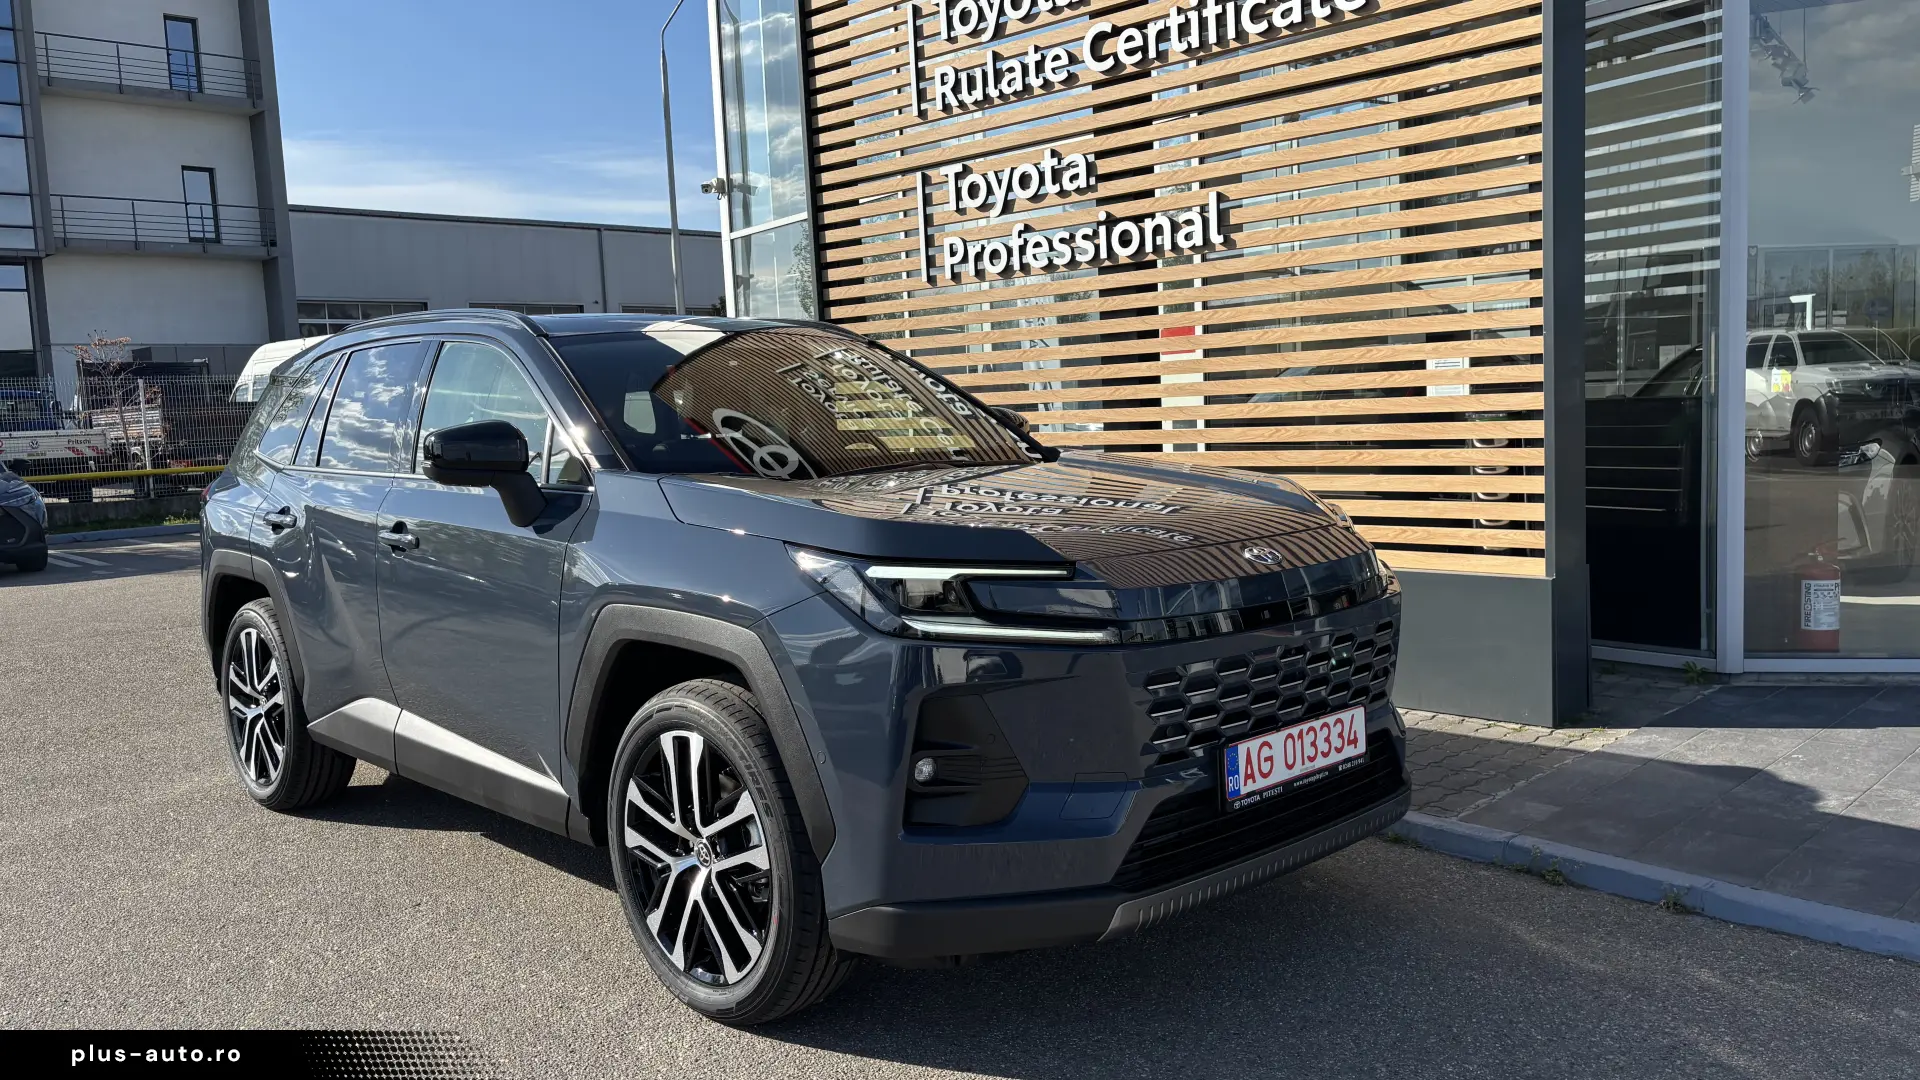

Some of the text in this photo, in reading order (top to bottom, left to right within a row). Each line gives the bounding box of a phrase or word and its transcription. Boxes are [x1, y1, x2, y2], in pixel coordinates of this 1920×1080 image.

[939, 0, 1080, 42] Toyo
[935, 45, 1068, 110] Rulate
[940, 148, 1088, 217] Toyota
[943, 191, 1223, 278] Professional
[1228, 774, 1240, 792] RO
[1243, 714, 1359, 787] AG 013334
[1240, 794, 1261, 807] TOYOTA
